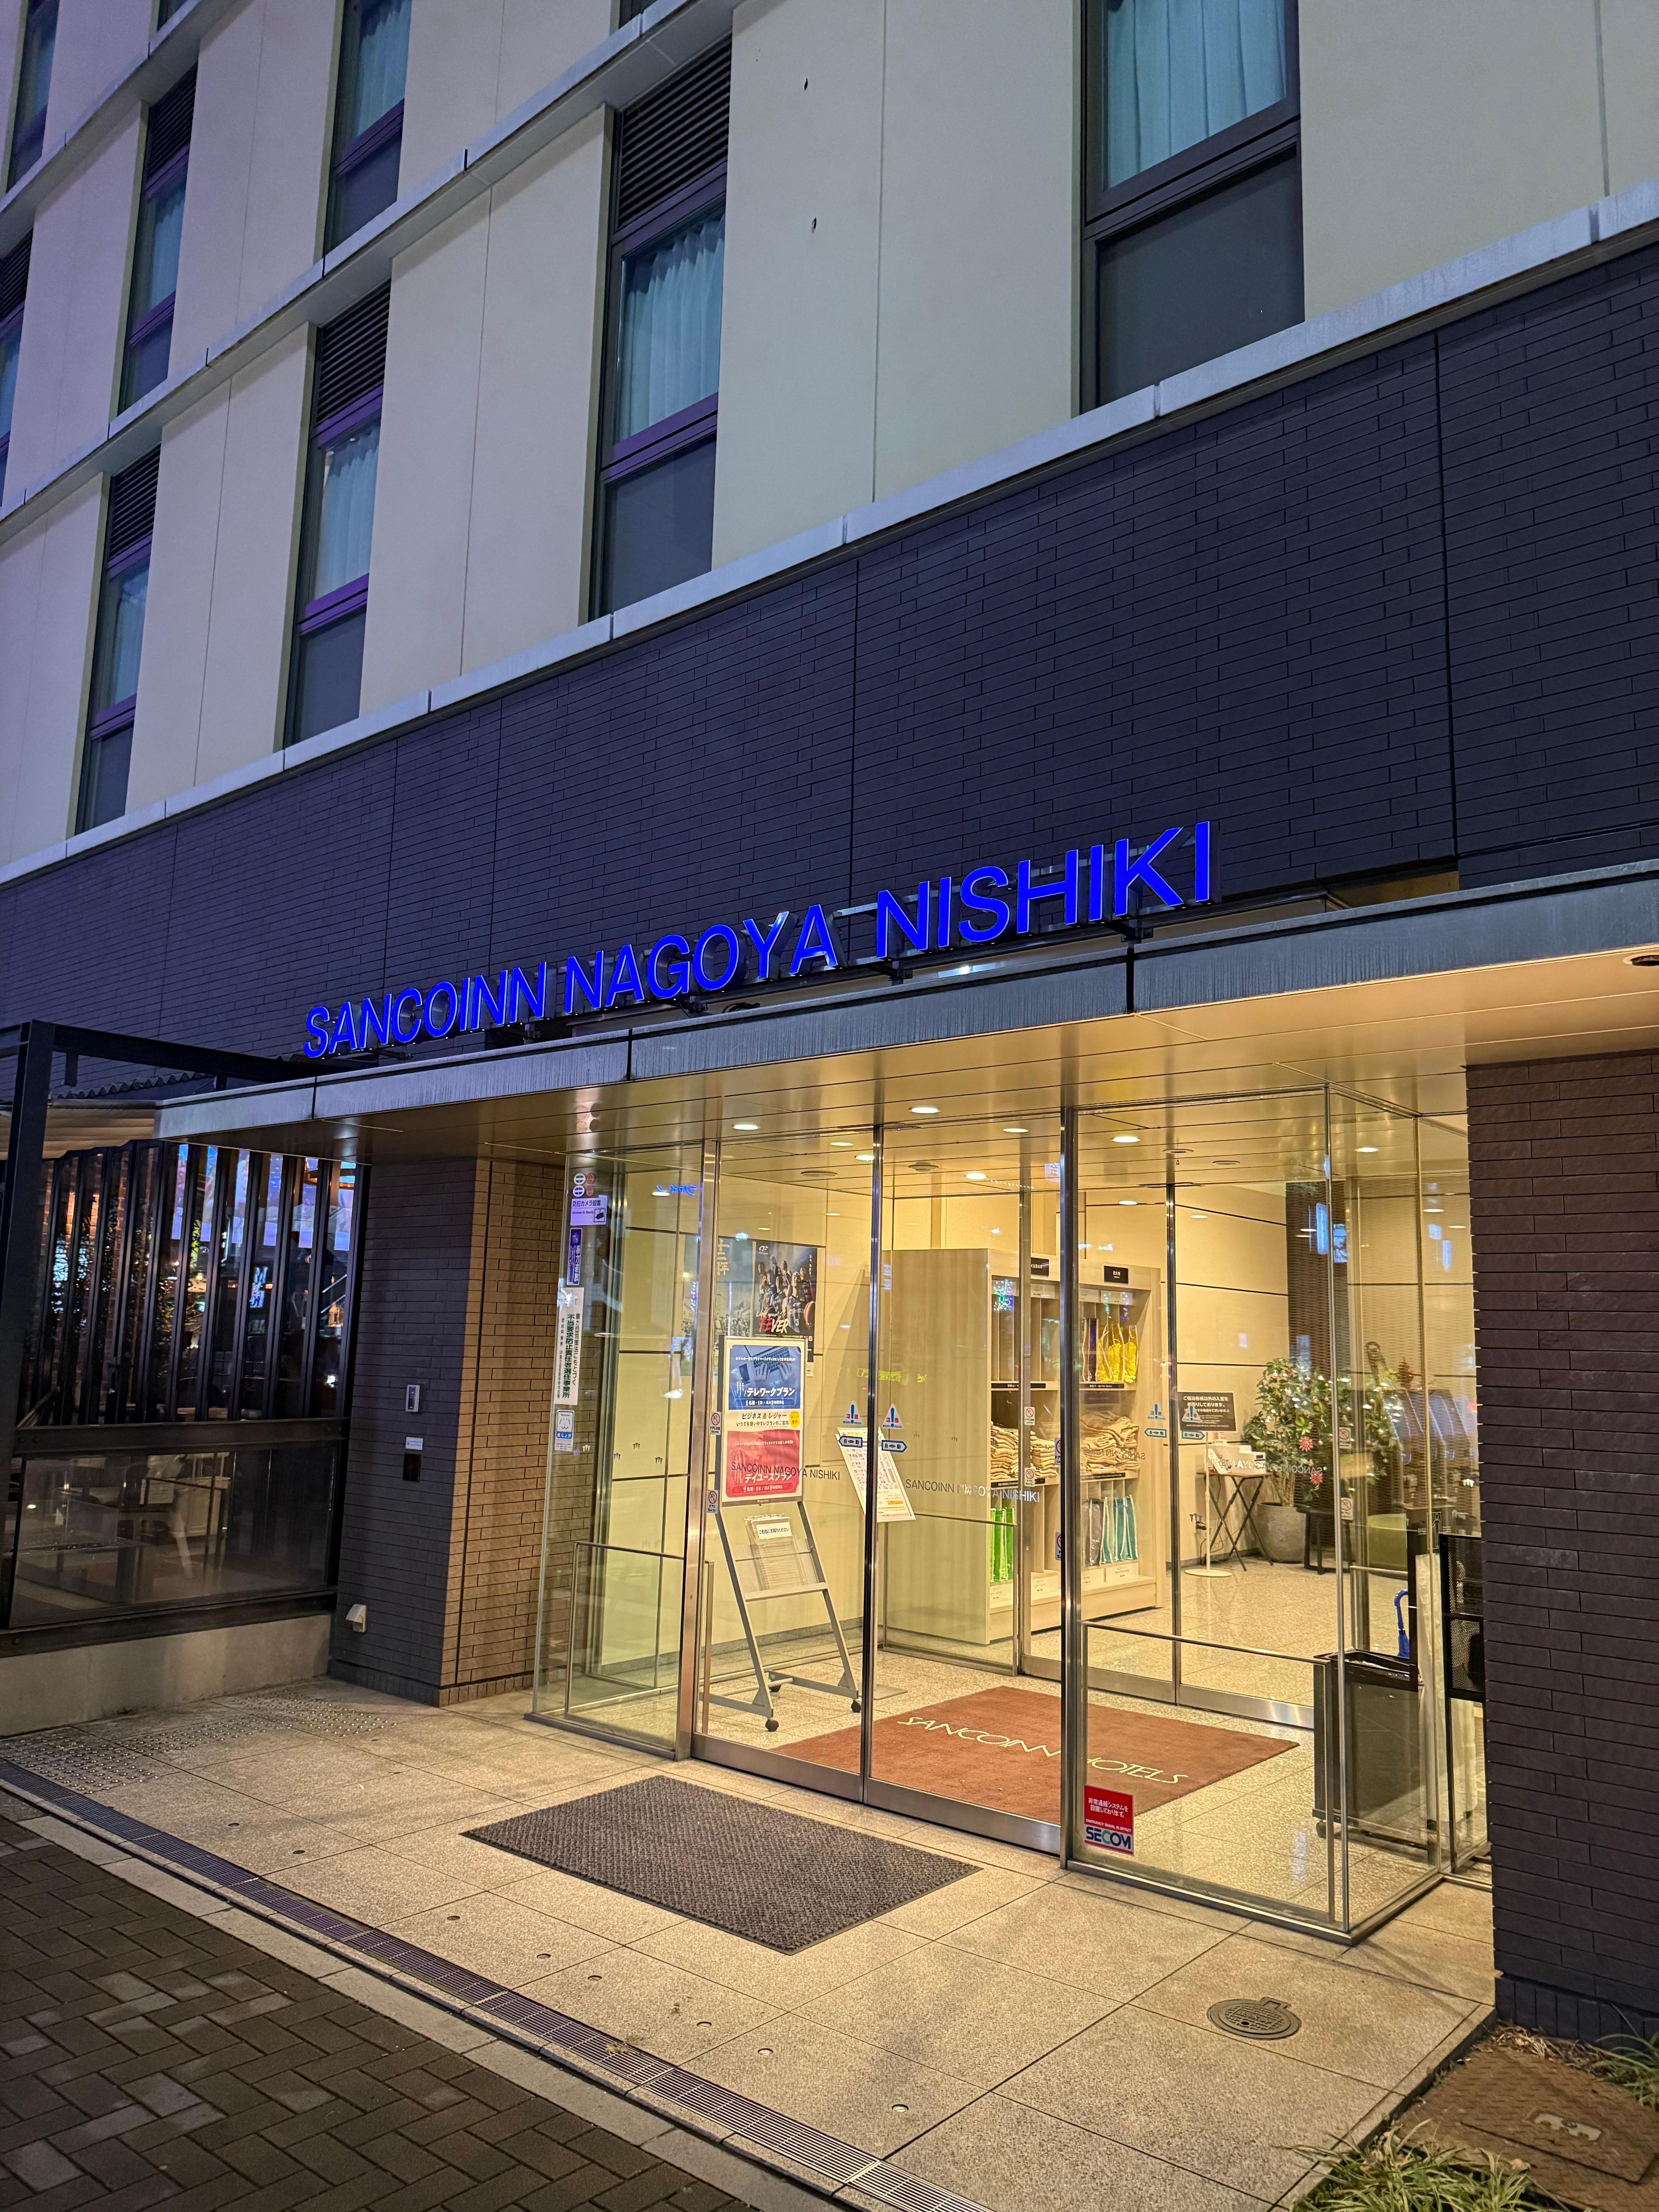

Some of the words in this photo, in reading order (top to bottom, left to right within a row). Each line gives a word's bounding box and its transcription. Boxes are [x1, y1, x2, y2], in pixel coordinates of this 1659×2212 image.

[303, 962, 545, 1058] SANCOINN
[564, 904, 839, 1013] NAGOYA
[876, 821, 1209, 958] NISHIKI
[759, 1316, 789, 1333] FEVER
[562, 1314, 575, 1398] 不当要求防止責任者選任事業所
[731, 1462, 771, 1473] SANCOINN
[774, 1465, 807, 1477] NAGOYA
[810, 1469, 840, 1480] NISHIKI
[905, 1479, 954, 1493] SANCOINN
[1002, 1489, 1040, 1502] NISHIKI
[1088, 1798, 1128, 1812] 非常通報システムを
[1090, 1805, 1124, 1818] 設置しております。
[1086, 1826, 1131, 1849] SECOM
